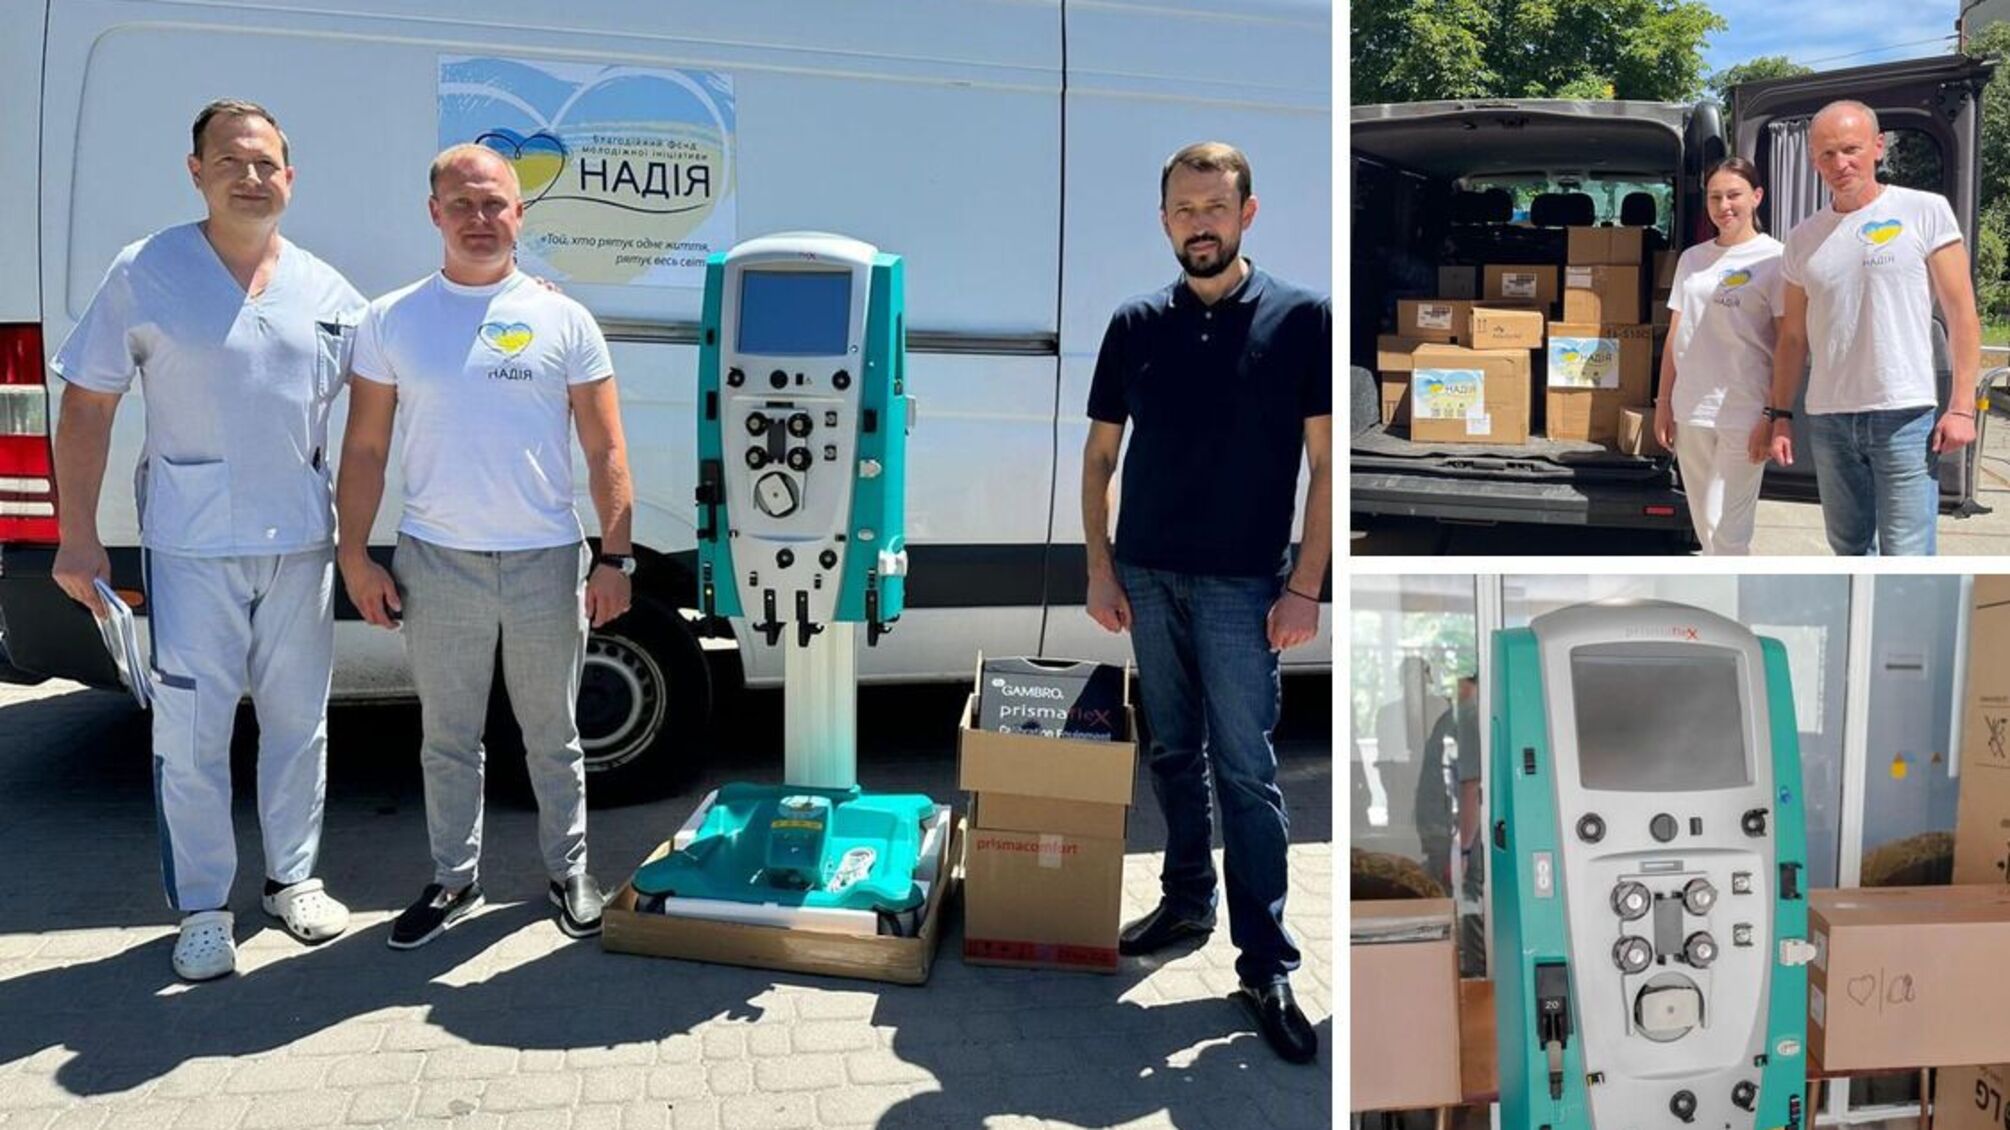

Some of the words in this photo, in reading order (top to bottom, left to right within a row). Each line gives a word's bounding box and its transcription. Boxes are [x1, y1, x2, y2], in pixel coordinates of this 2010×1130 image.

[580, 157, 710, 199] НАДІЯ
[1545, 1000, 1560, 1010] 20
[1976, 1078, 2002, 1123] LG
